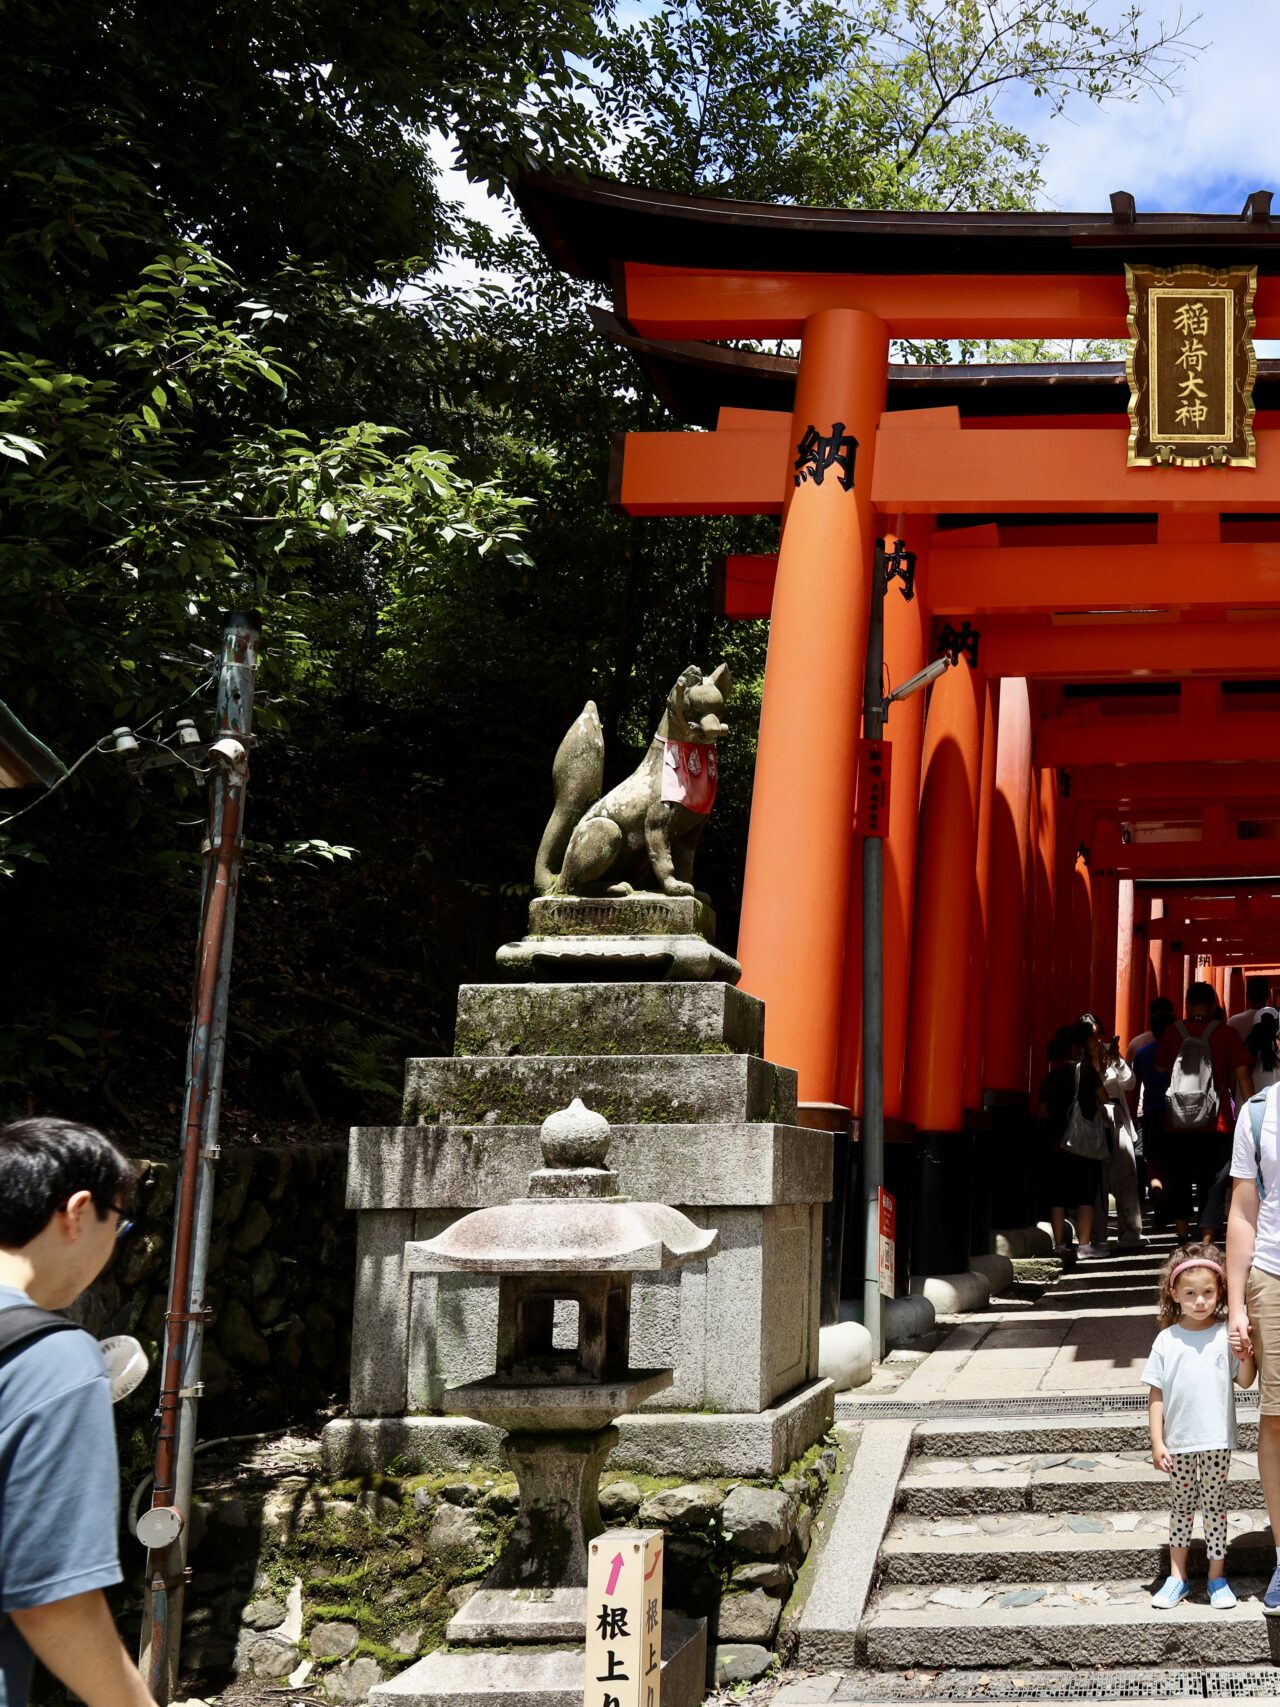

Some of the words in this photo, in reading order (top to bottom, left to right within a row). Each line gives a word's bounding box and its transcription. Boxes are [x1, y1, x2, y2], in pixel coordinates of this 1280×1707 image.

[1172, 302, 1210, 430] 稲荷大神
[794, 422, 860, 493] 納
